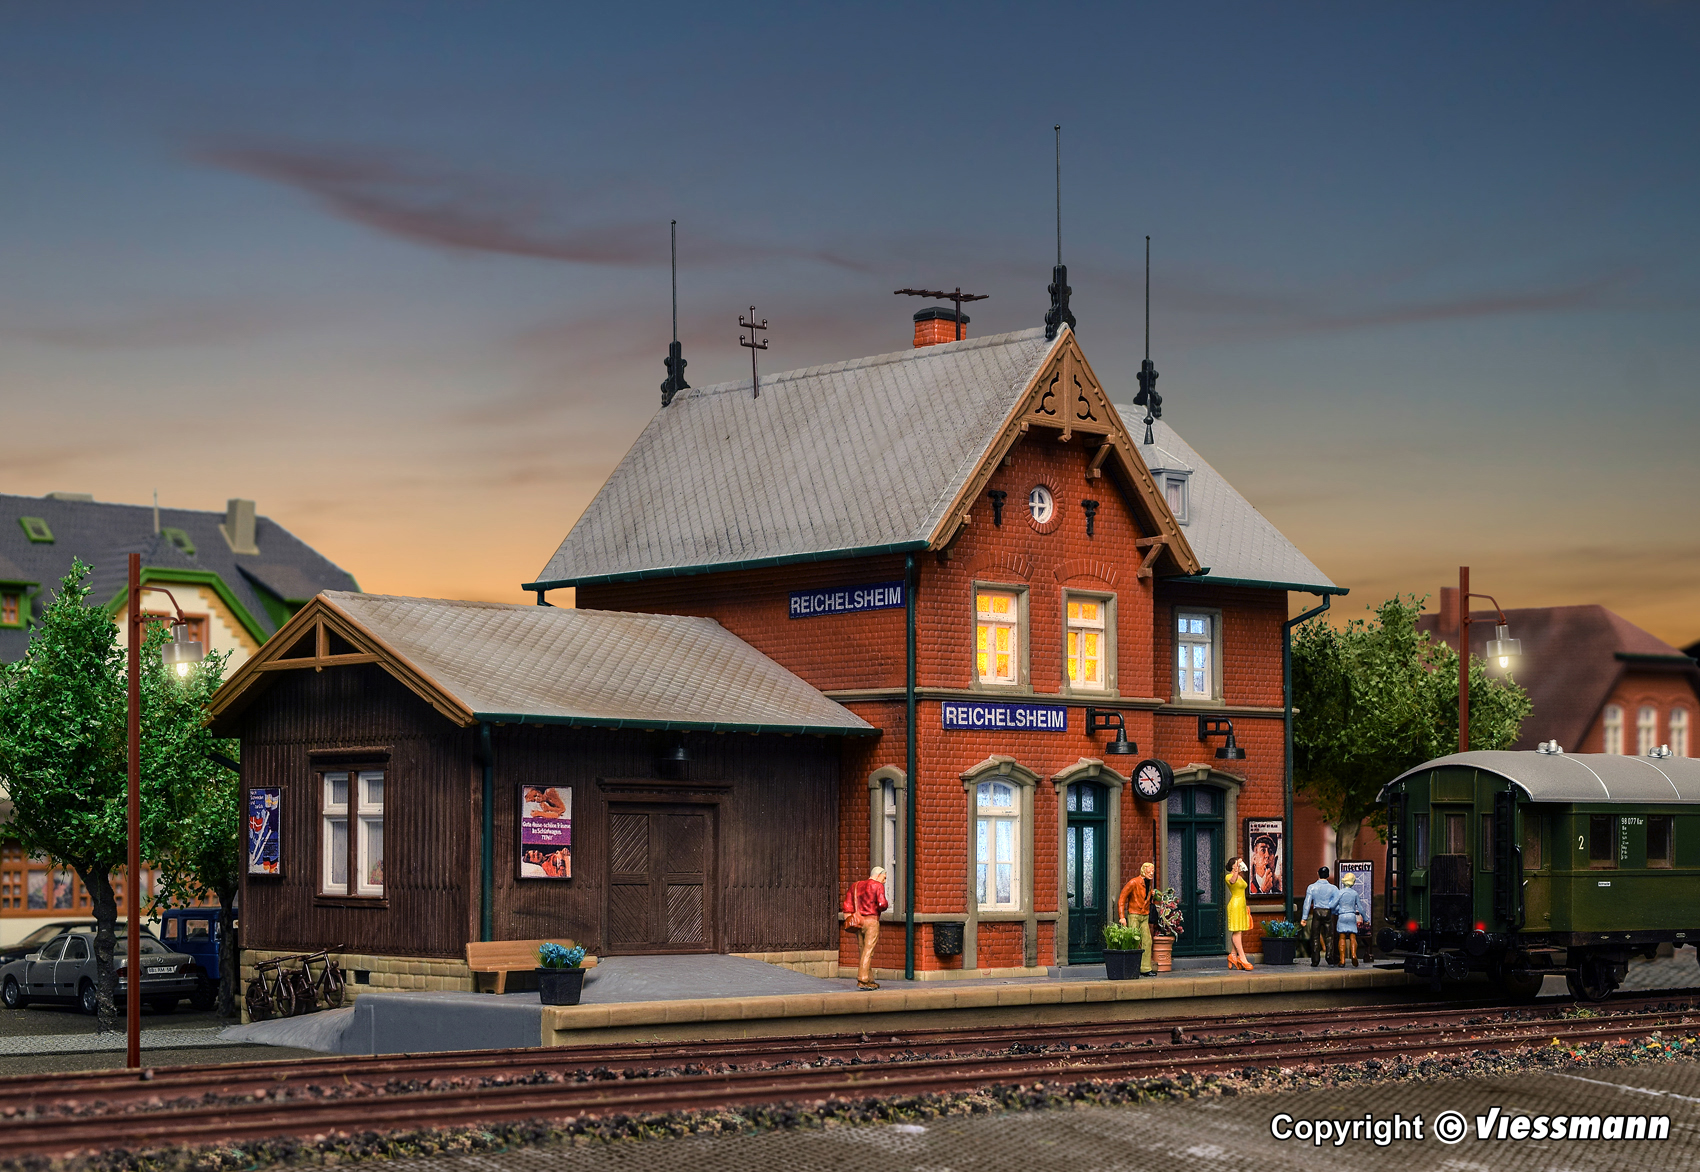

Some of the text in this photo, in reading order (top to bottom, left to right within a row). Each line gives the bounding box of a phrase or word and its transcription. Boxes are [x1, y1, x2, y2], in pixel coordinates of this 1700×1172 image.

[790, 586, 901, 614] REICHELSHEIM
[946, 706, 1064, 728] REICHELSHEIM
[1578, 835, 1585, 850] 2
